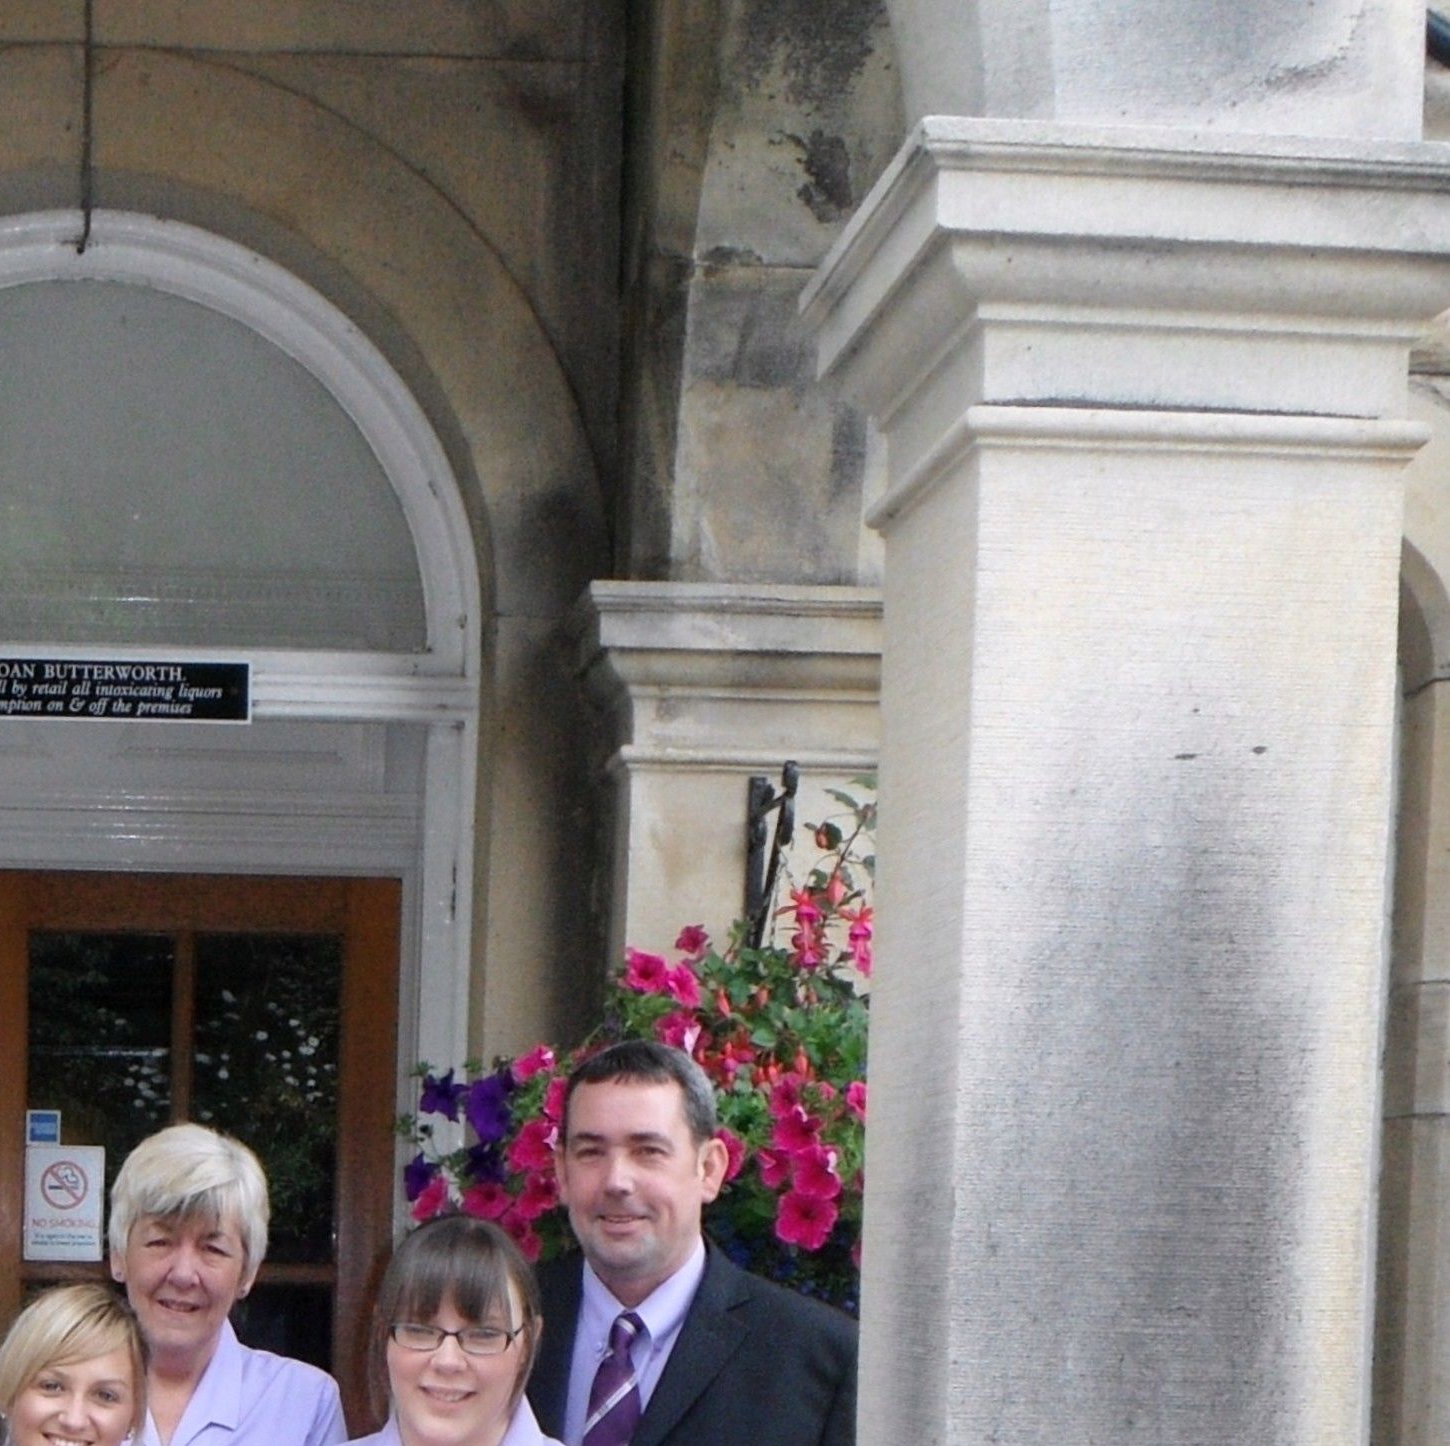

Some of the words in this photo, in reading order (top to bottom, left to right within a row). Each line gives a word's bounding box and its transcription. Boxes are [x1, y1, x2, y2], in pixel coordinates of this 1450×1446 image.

[12, 680, 27, 697] by
[32, 680, 67, 695] retail
[72, 681, 90, 695] all
[179, 683, 223, 701] liquors
[47, 701, 64, 711] on
[69, 699, 86, 712] &
[89, 698, 110, 715] off
[113, 700, 131, 713] the
[136, 701, 193, 716] premises
[32, 1218, 46, 1228] NO
[50, 1218, 95, 1229] SMOKING
